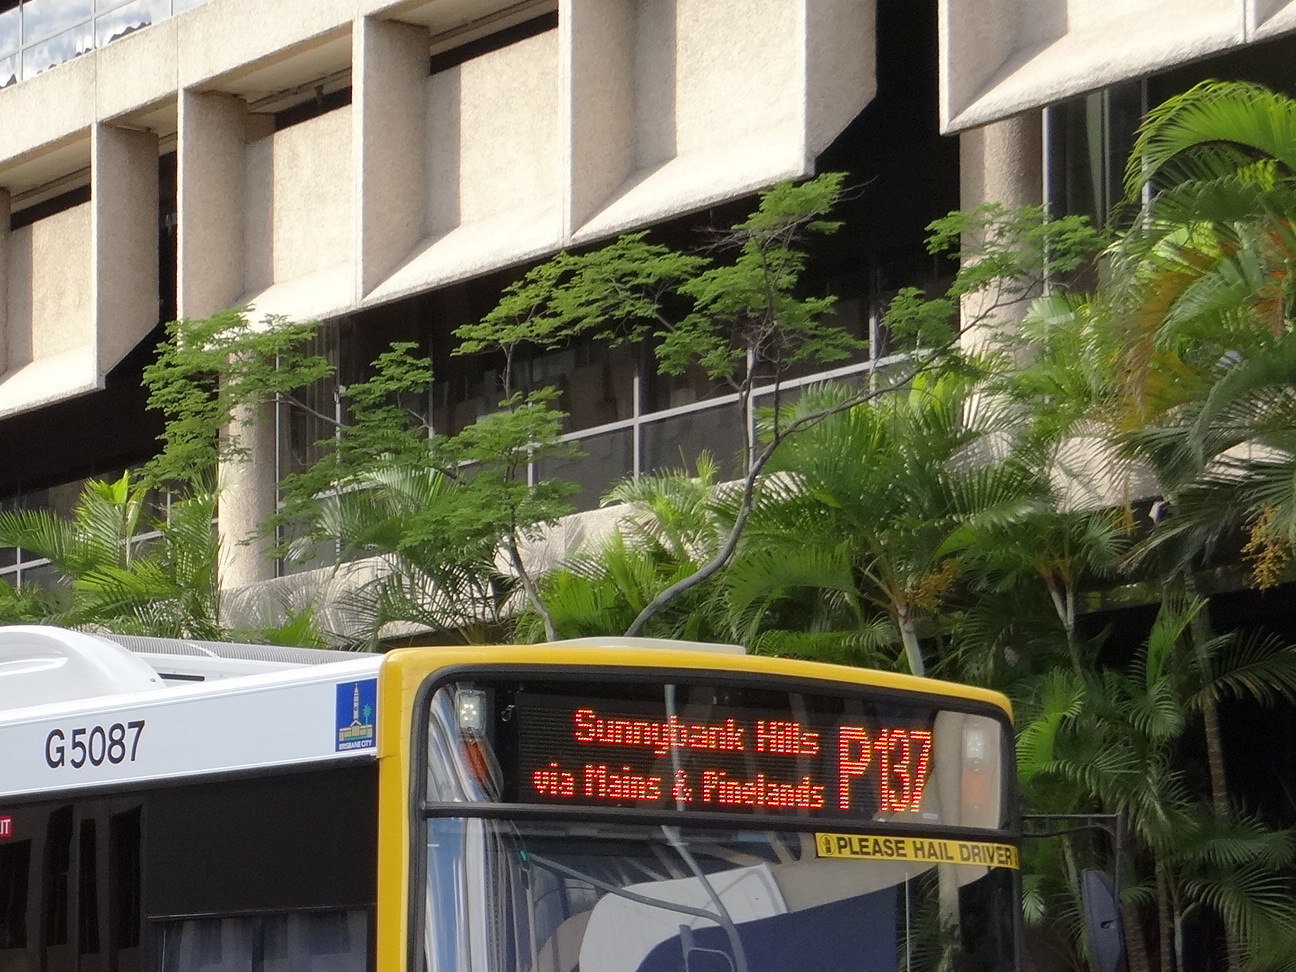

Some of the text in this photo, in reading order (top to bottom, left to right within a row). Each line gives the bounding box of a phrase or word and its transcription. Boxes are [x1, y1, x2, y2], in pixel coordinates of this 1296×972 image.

[44, 719, 146, 769] G5087
[338, 739, 373, 751] BRISBANE CITY
[574, 708, 821, 756] Sunnybank Hills
[532, 762, 825, 809] via Mains & Pinelands
[837, 724, 934, 813] P137
[836, 836, 1013, 866] PLEASE HAIL DRIVER
